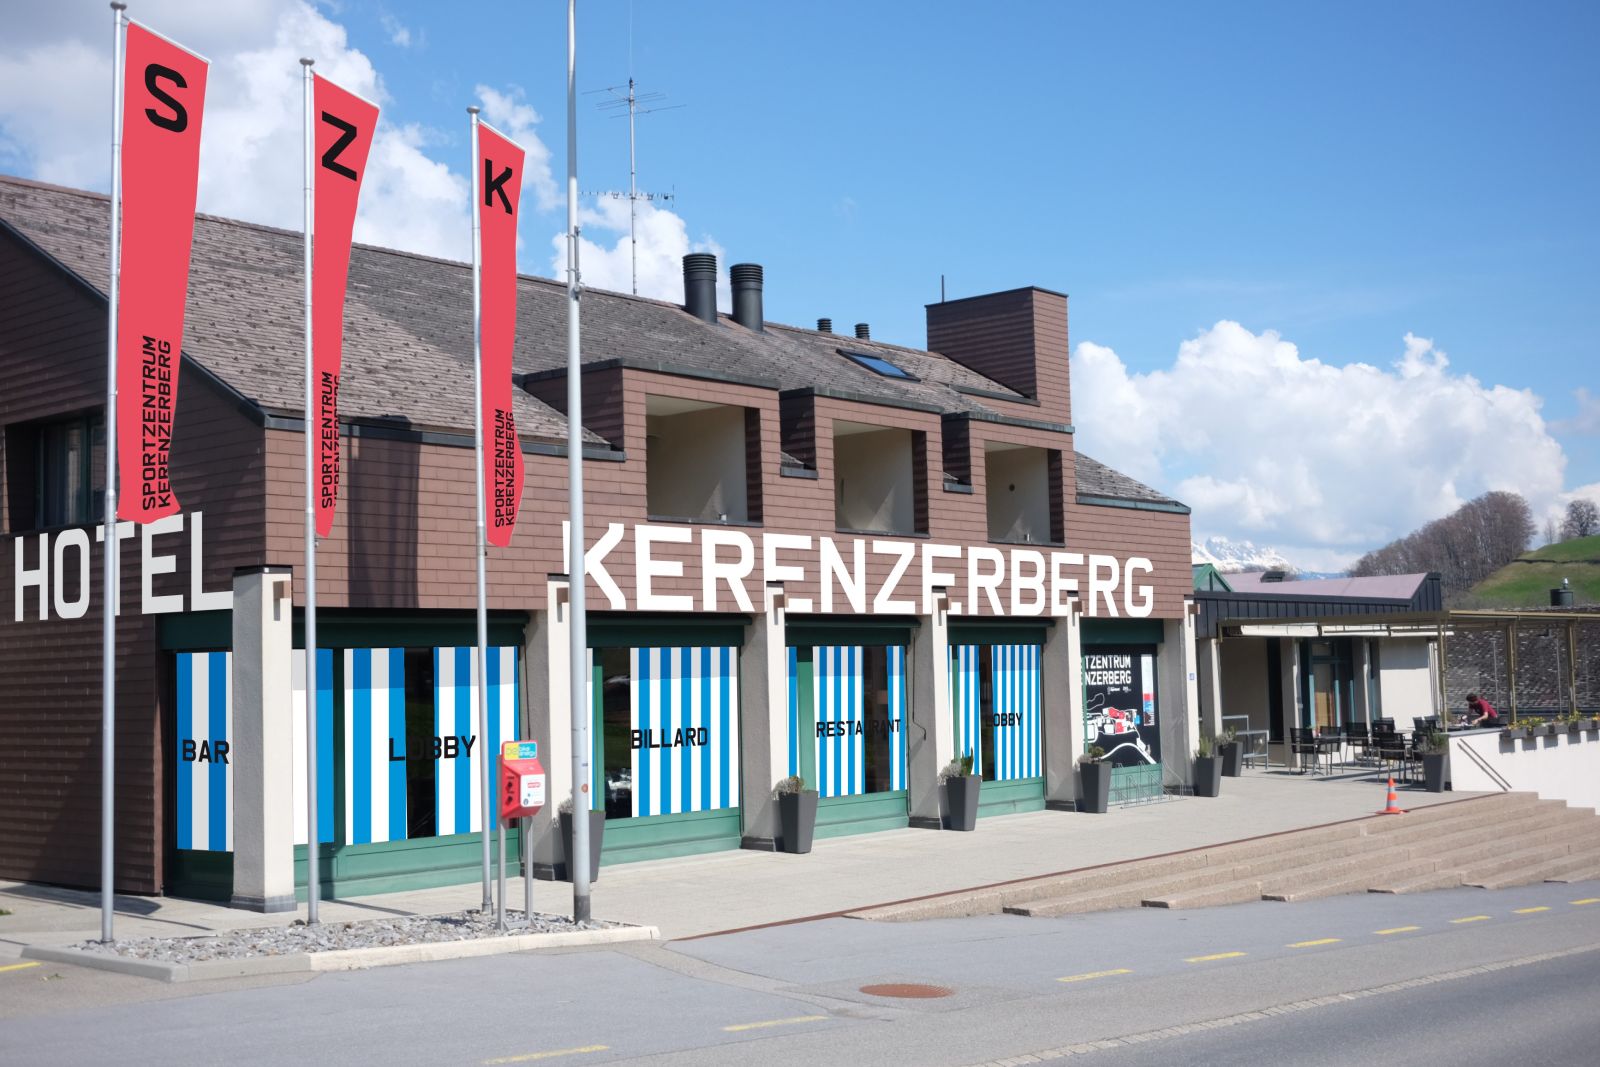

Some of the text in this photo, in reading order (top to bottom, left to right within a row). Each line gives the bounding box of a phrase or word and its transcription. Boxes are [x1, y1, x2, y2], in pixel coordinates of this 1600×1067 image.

[145, 63, 188, 133] S
[321, 111, 357, 181] Z
[484, 159, 513, 215] K
[143, 335, 156, 511] SPORTZENTRUM
[158, 340, 171, 508] KERENZERBERG
[322, 372, 333, 509] SPORTZENTRUM
[495, 409, 505, 528] SPORTZENTRUM
[506, 412, 515, 526] KERENZERBERG
[15, 511, 233, 622] HOTEL
[562, 520, 1154, 618] KERENZERBERG
[1085, 654, 1131, 669] TZENTRUM
[1085, 670, 1132, 685] NZERBERG
[182, 739, 230, 764] BAR
[631, 727, 708, 749] BILLARD
[816, 719, 901, 738] RESTARANT
